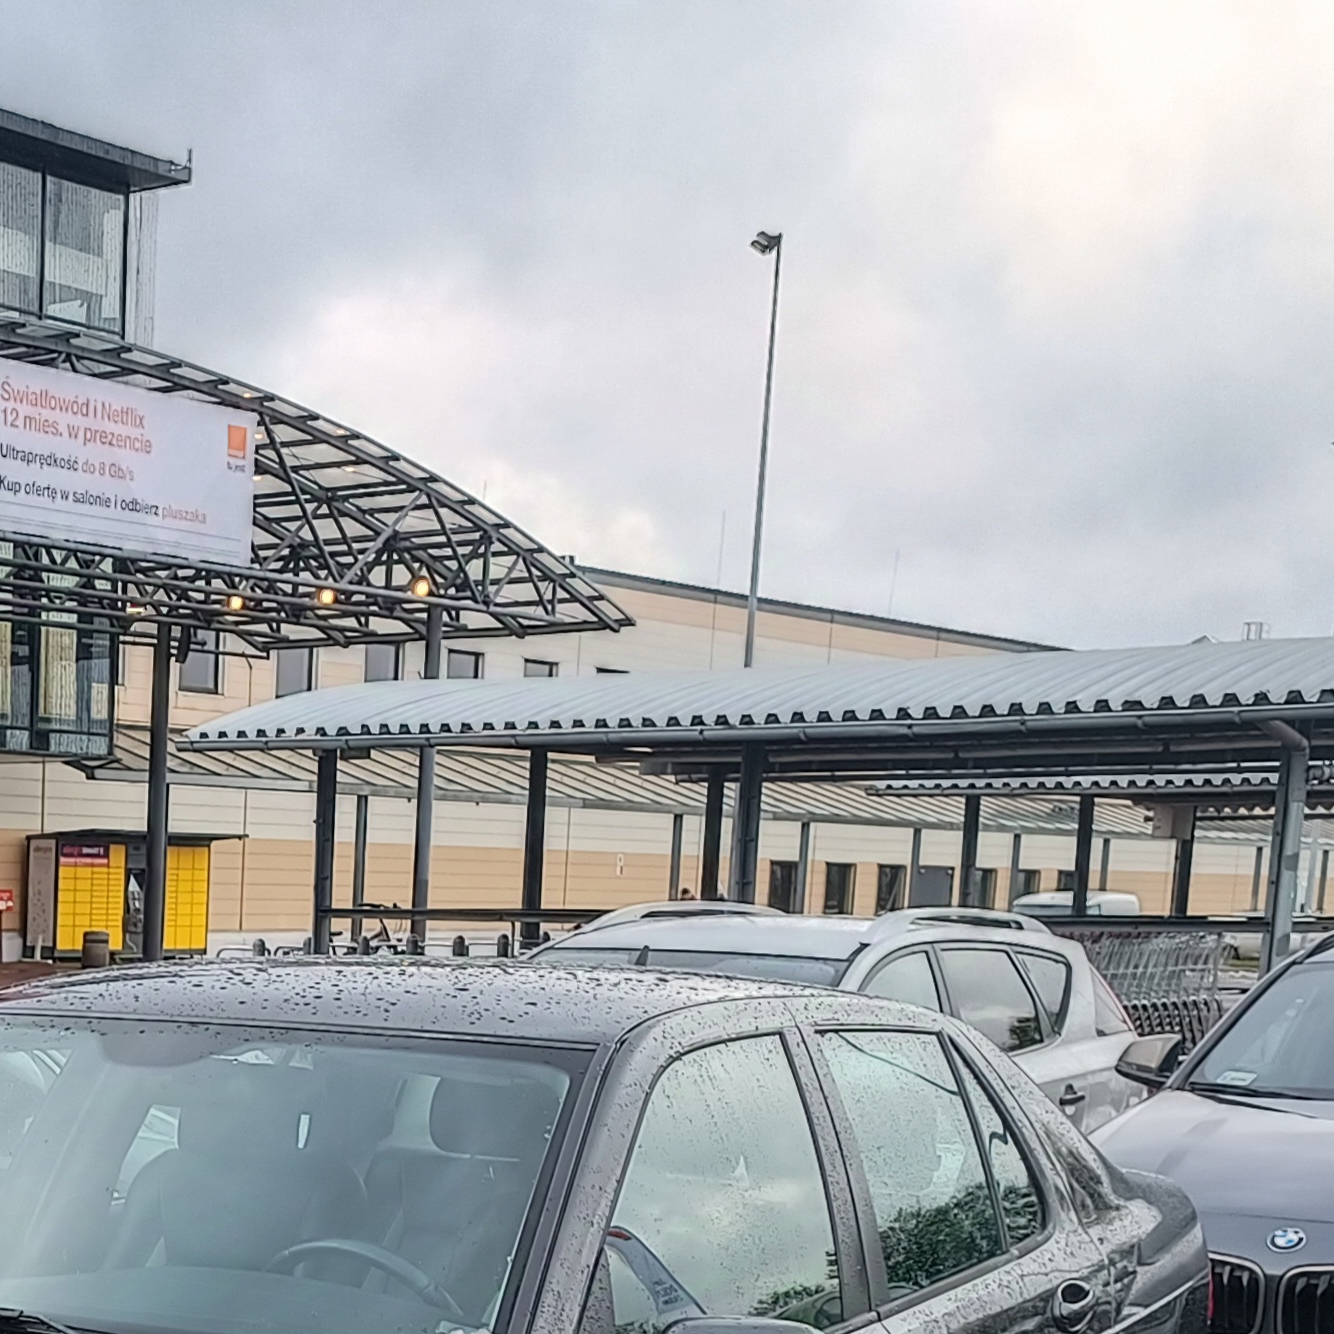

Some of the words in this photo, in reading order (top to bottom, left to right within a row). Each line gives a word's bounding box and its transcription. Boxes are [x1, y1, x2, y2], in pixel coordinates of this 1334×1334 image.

[0, 375, 89, 417] Światłowód
[101, 401, 145, 430] Netflix
[1, 406, 19, 429] 12
[23, 412, 63, 438] mies.
[66, 423, 80, 440] w
[83, 427, 153, 455] prezencie
[0, 442, 79, 472] Ultraprędkość
[81, 458, 96, 474] do
[98, 462, 106, 476] 8
[109, 463, 135, 482] Gb/s
[24, 480, 58, 503] ofertę
[60, 488, 69, 501] w
[72, 488, 111, 509] salonie
[120, 497, 160, 517] odbierz
[161, 505, 207, 525] pluszaka
